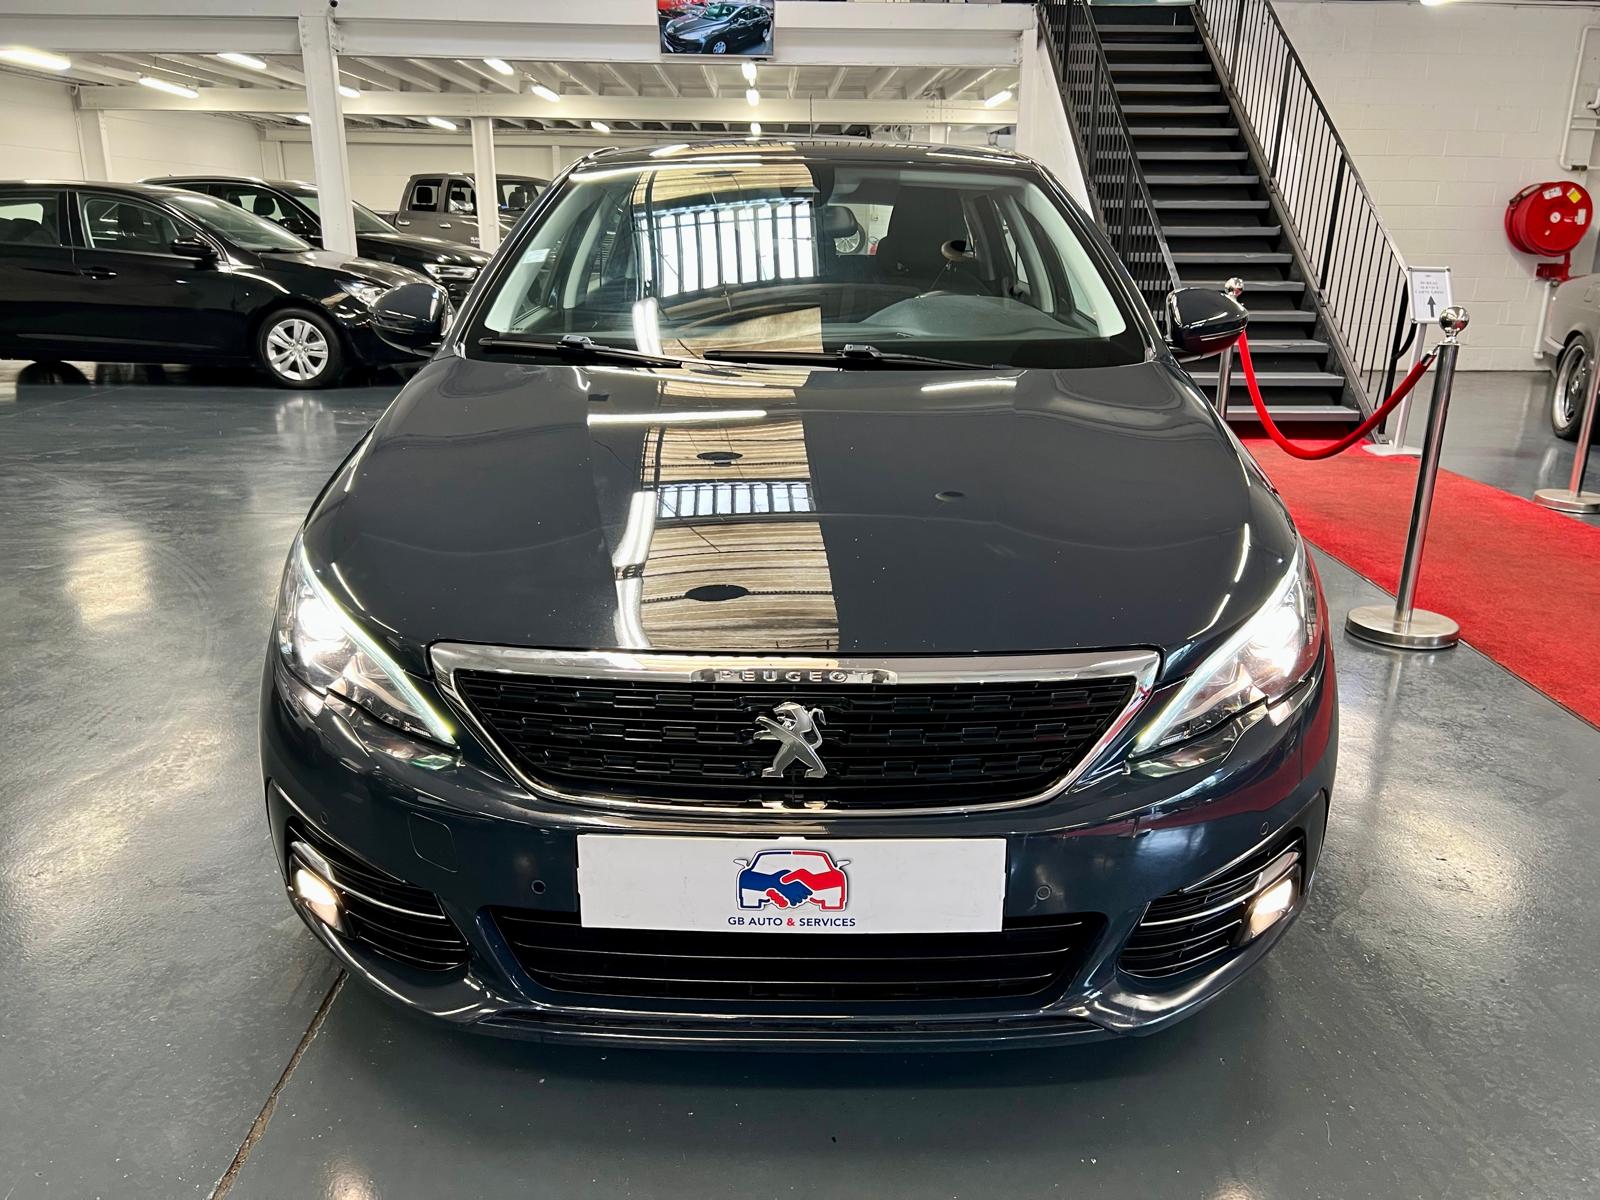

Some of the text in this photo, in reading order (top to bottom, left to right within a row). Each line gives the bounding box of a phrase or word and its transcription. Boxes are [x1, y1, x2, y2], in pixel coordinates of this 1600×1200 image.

[728, 917, 856, 927] GB AUTO & SERVICES
